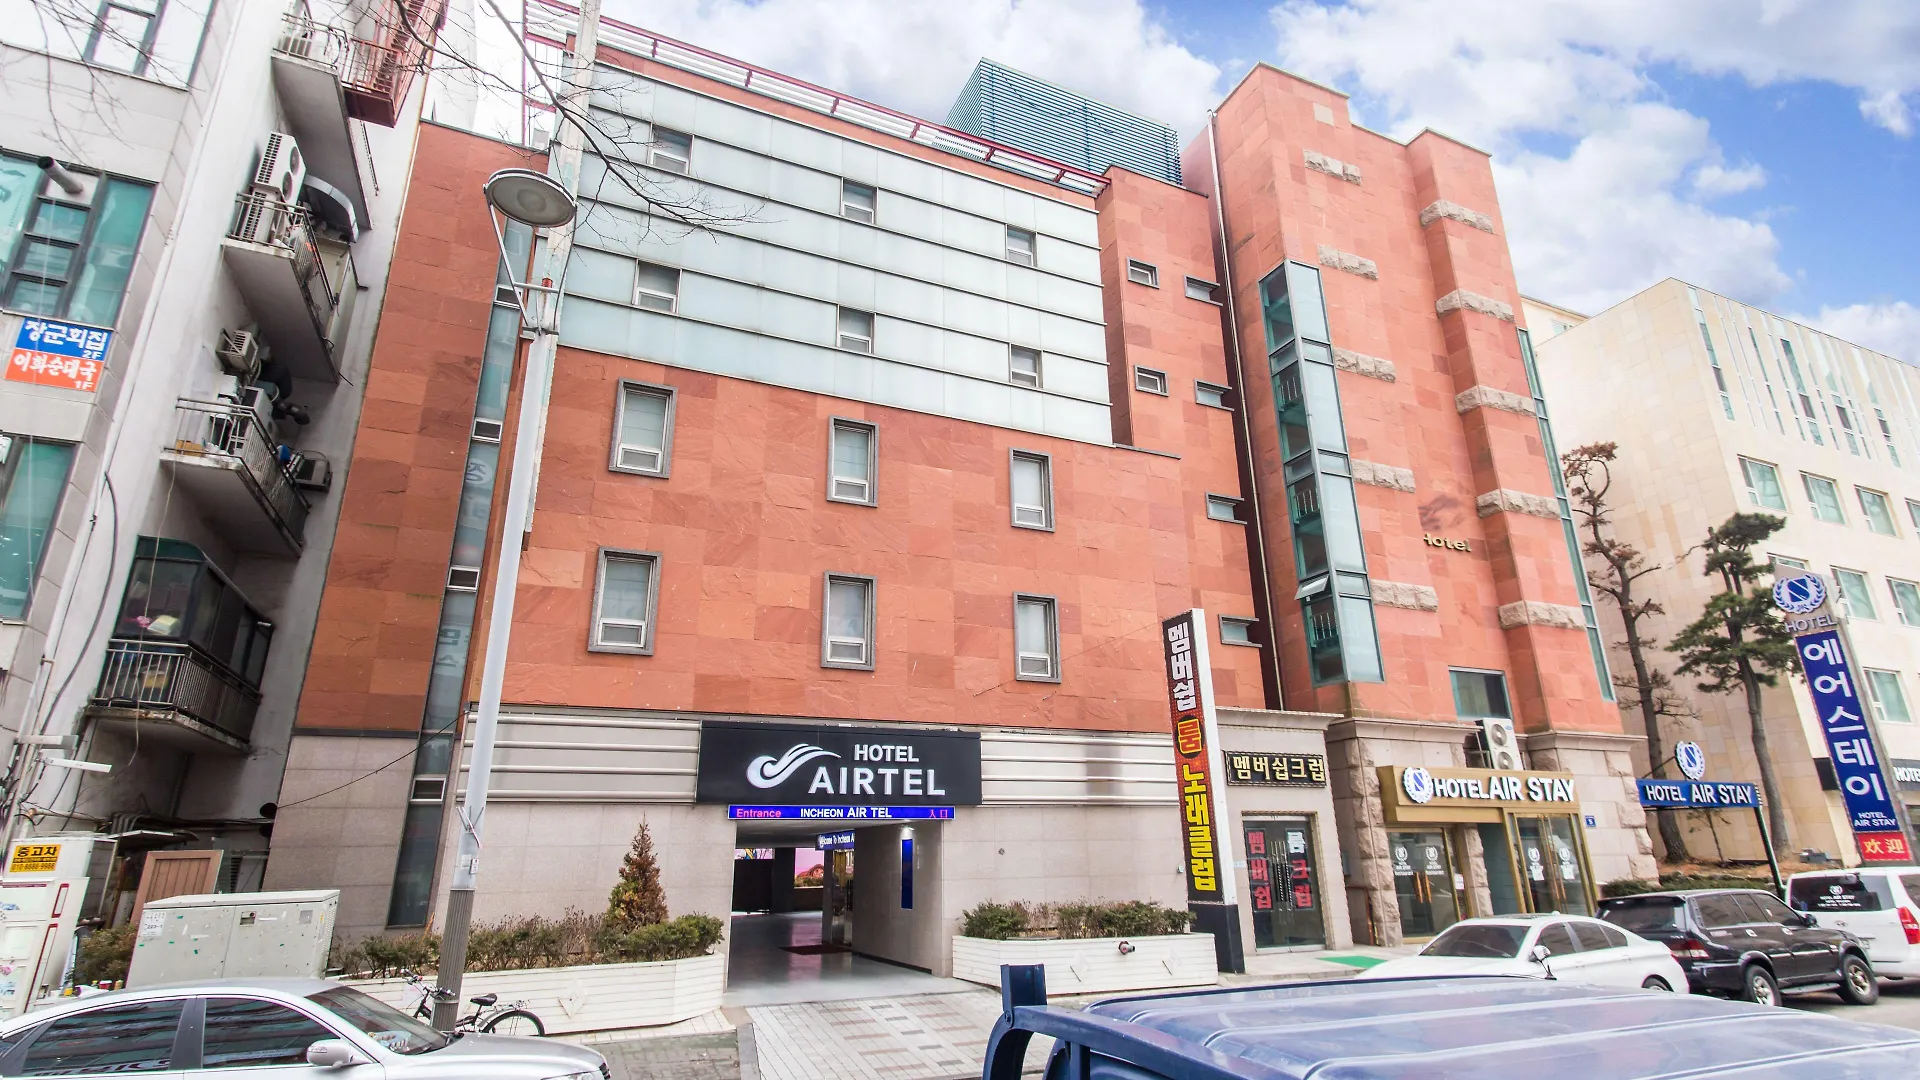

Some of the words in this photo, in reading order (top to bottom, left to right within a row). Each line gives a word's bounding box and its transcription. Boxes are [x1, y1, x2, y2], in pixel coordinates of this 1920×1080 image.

[25, 320, 108, 351] 장군회집
[82, 350, 102, 359] 2F
[14, 352, 97, 381] 이화순대국
[75, 380, 94, 389] 1F
[1785, 614, 1838, 633] HOTEL
[1167, 622, 1197, 711] 멤버쉽
[1803, 638, 1885, 801] 에어스테이
[1178, 719, 1202, 754] 룸
[854, 744, 920, 763] HOTEL
[1233, 756, 1326, 782] 멤버쉽크럽
[807, 766, 946, 796] AIRTEL
[1433, 778, 1489, 799] HOTEL
[1489, 776, 1524, 800] AIR
[1527, 777, 1574, 802] STAY
[1645, 784, 1686, 801] HOTEL
[1691, 783, 1717, 803] AIR
[1717, 784, 1752, 804] STAY
[736, 808, 781, 818] Entrance
[800, 808, 843, 818] INCHEON
[847, 807, 866, 818] AIR
[871, 807, 892, 818] TEL
[1854, 819, 1871, 827] AIR
[1872, 819, 1896, 827] STAY
[1858, 811, 1887, 819] HOTEL
[1182, 764, 1217, 892] 노래클럽
[1863, 838, 1905, 854] 欢迎
